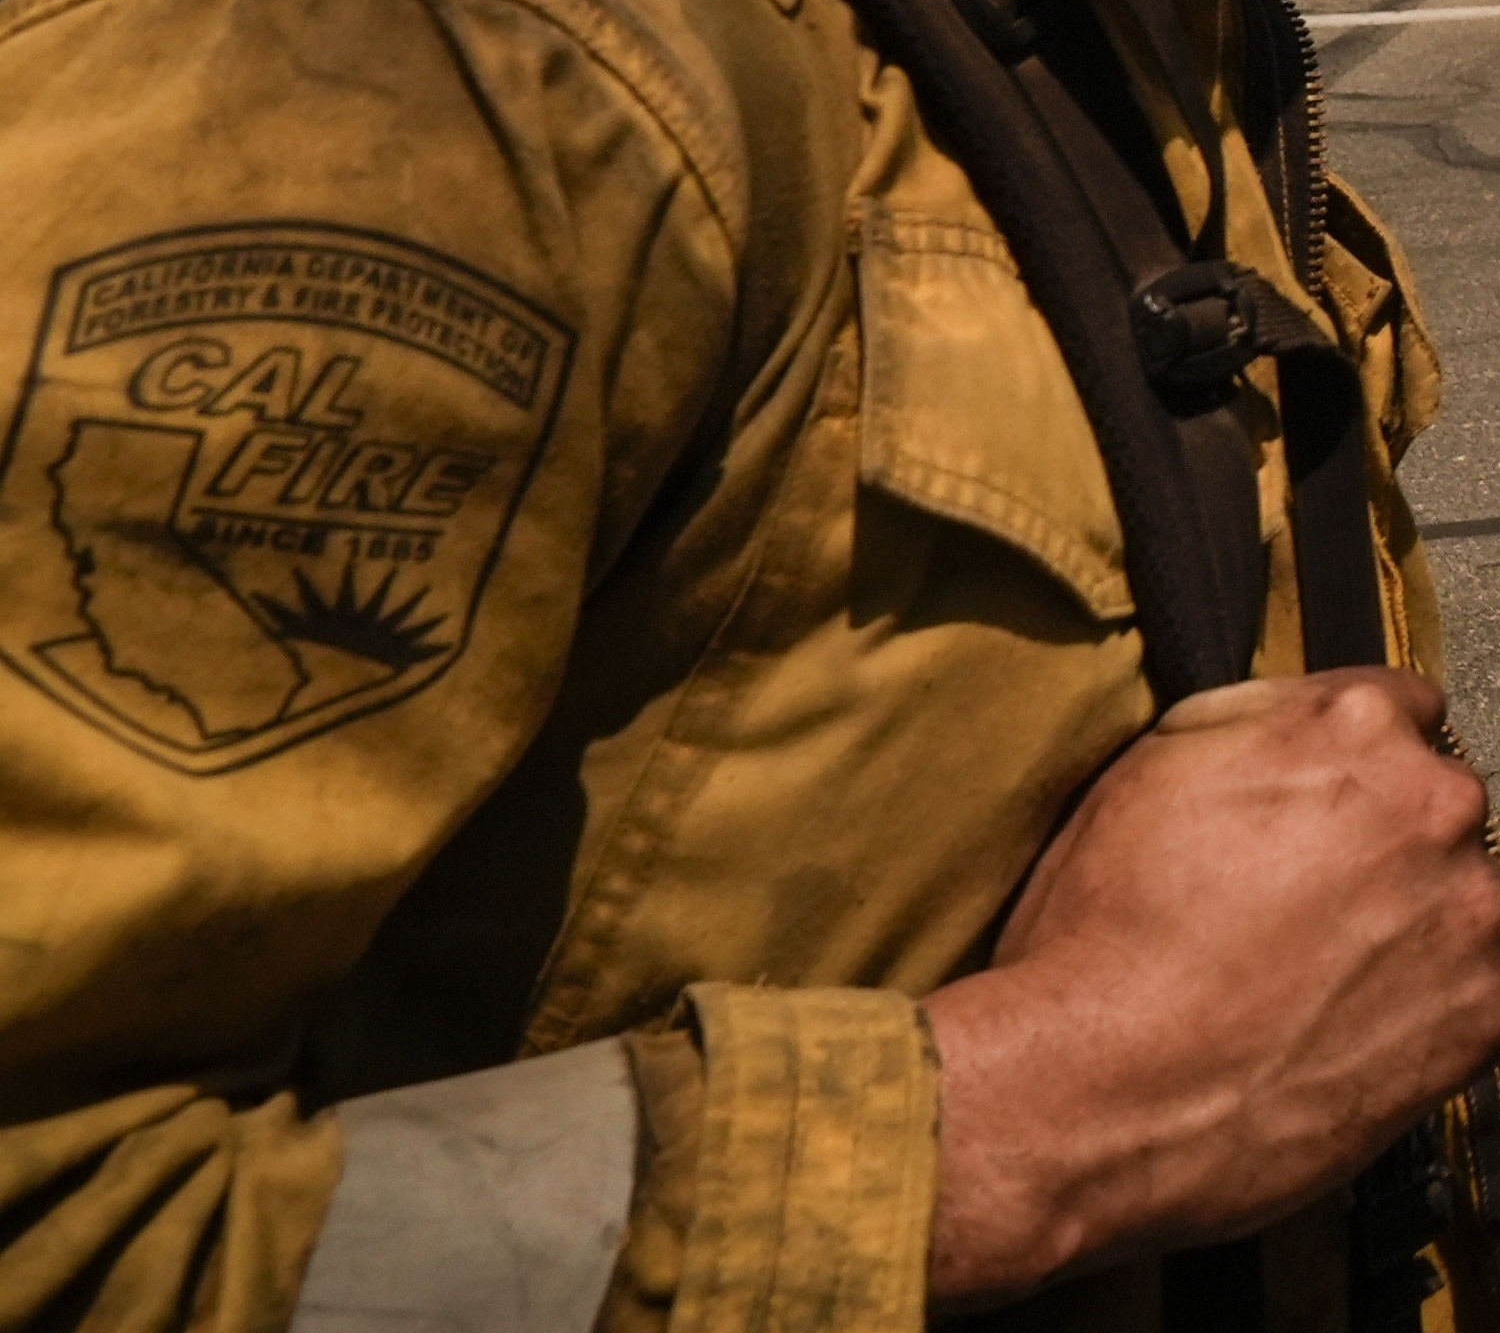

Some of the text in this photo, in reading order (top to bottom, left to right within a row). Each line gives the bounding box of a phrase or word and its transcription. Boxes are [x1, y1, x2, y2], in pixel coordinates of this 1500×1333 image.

[92, 253, 295, 308] CALIFORNIA
[306, 253, 494, 333] DEPARTMENT
[85, 284, 249, 336] FORESTRY
[292, 285, 360, 315] FIRE
[369, 293, 532, 393] PROTECTION
[125, 336, 365, 426] CAL
[206, 429, 496, 518] FIRE
[194, 518, 438, 564] SINCE 1885
